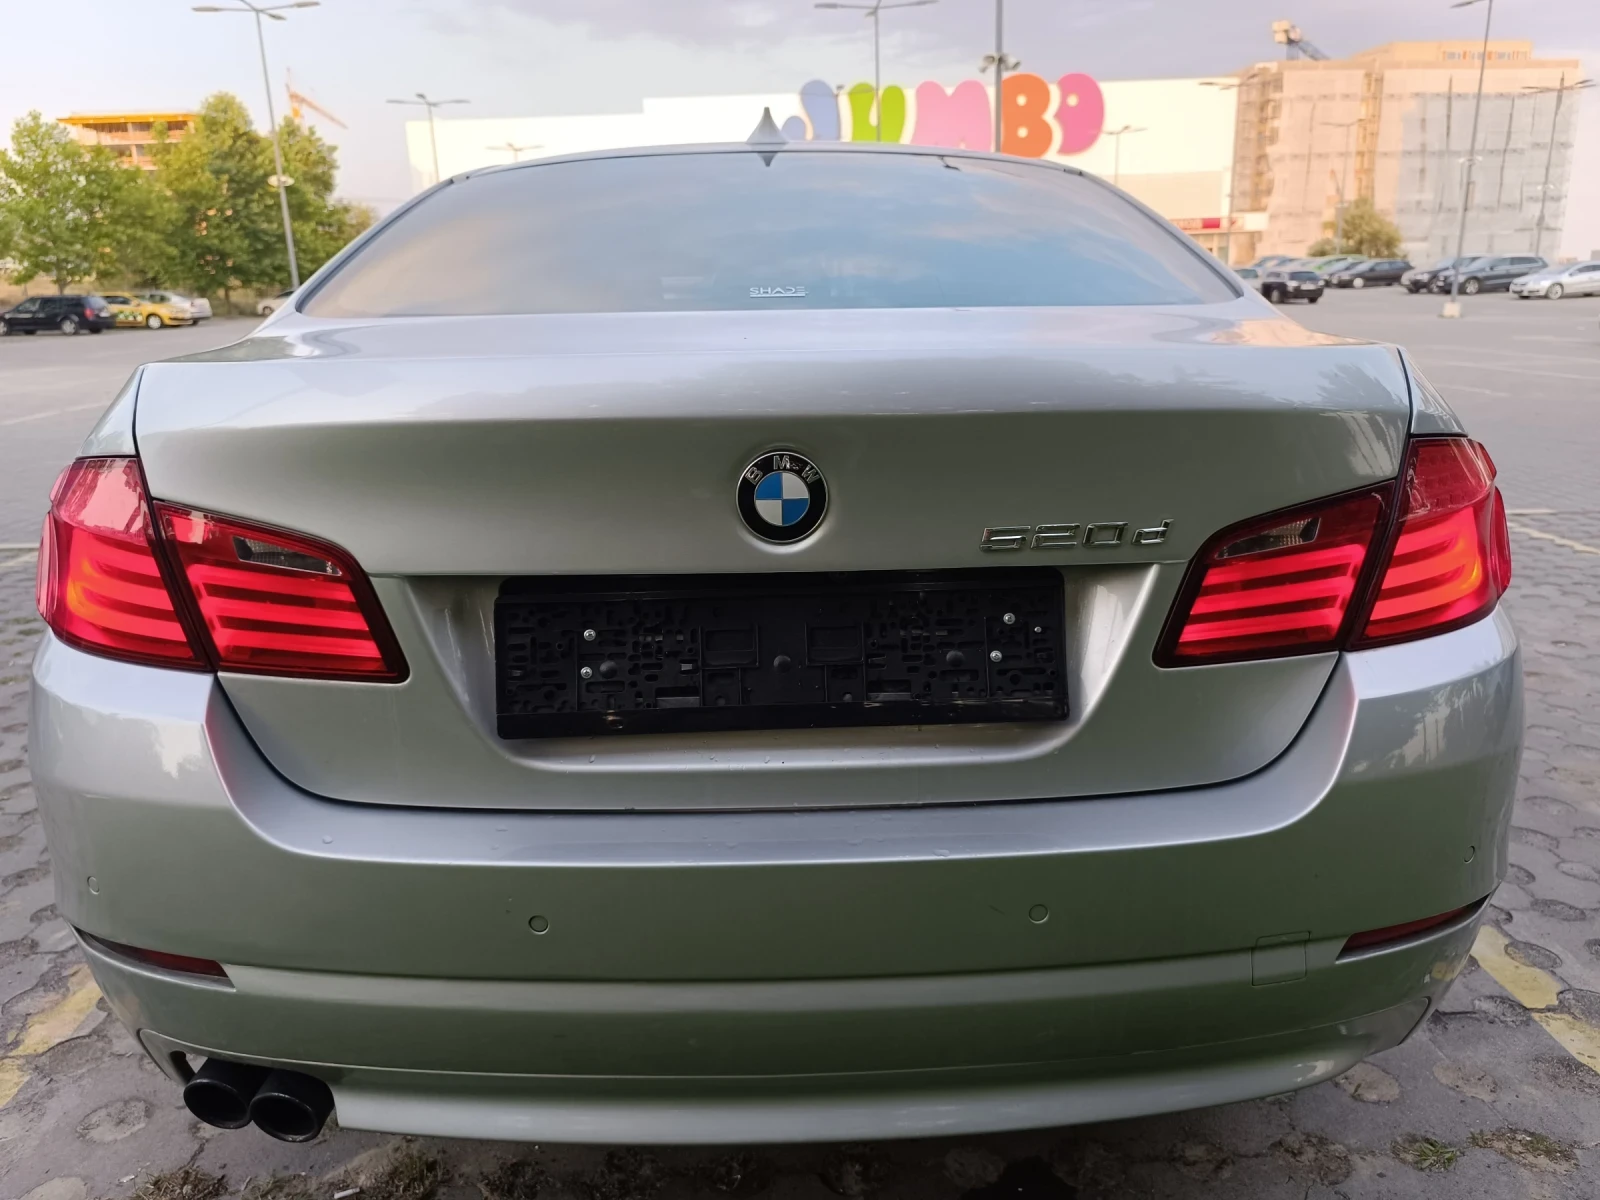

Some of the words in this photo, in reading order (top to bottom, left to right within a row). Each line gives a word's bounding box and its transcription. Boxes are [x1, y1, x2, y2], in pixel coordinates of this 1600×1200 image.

[782, 73, 1105, 158] JUMBO
[749, 286, 805, 295] SHADE
[744, 455, 820, 485] BMW
[980, 518, 1174, 550] 520d
